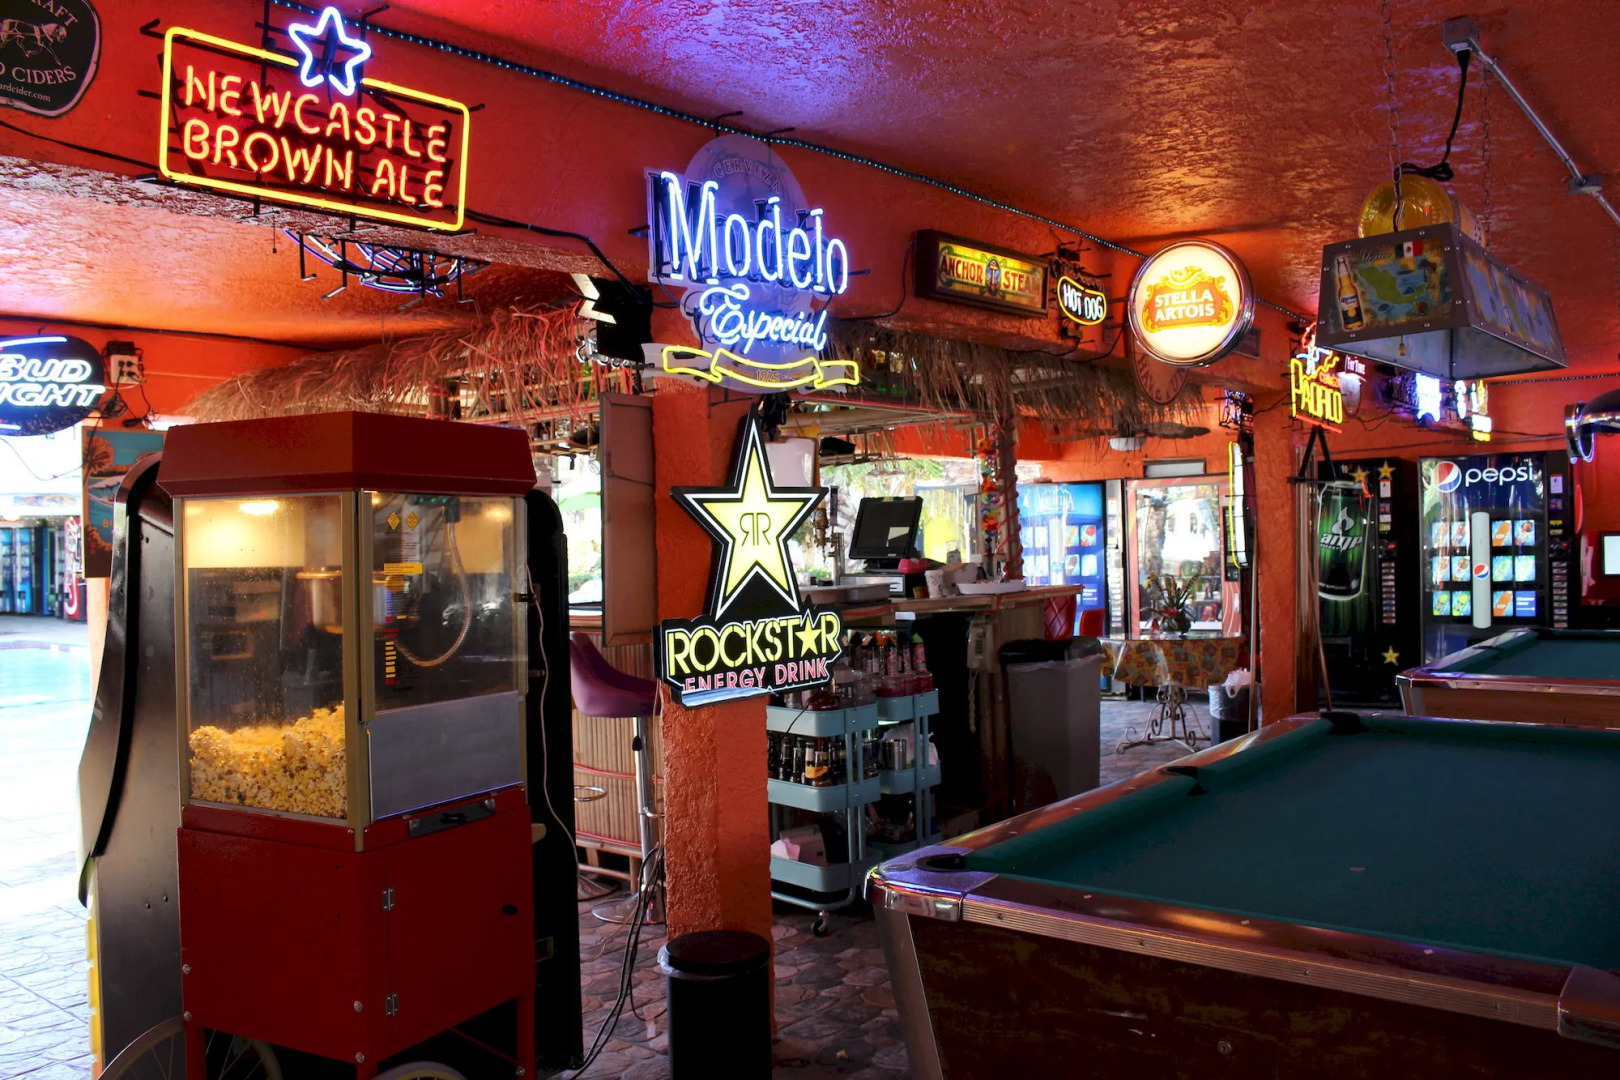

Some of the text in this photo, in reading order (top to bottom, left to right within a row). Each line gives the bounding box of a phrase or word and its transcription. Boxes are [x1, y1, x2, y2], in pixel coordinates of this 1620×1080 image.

[12, 66, 77, 85] CIDERS
[184, 64, 447, 164] NEWCASTLE
[183, 118, 444, 209] BROWN ALE
[713, 158, 781, 194] CERVEZA
[659, 171, 848, 295] Modelo
[940, 254, 983, 284] ANCHOR
[1063, 283, 1104, 320] HOT DOG
[1154, 291, 1215, 308] STELLA
[1154, 303, 1216, 322] ARTOIS
[699, 284, 827, 354] Especial
[1465, 464, 1534, 487] pepsi
[685, 656, 827, 691] ENERGY DRINK
